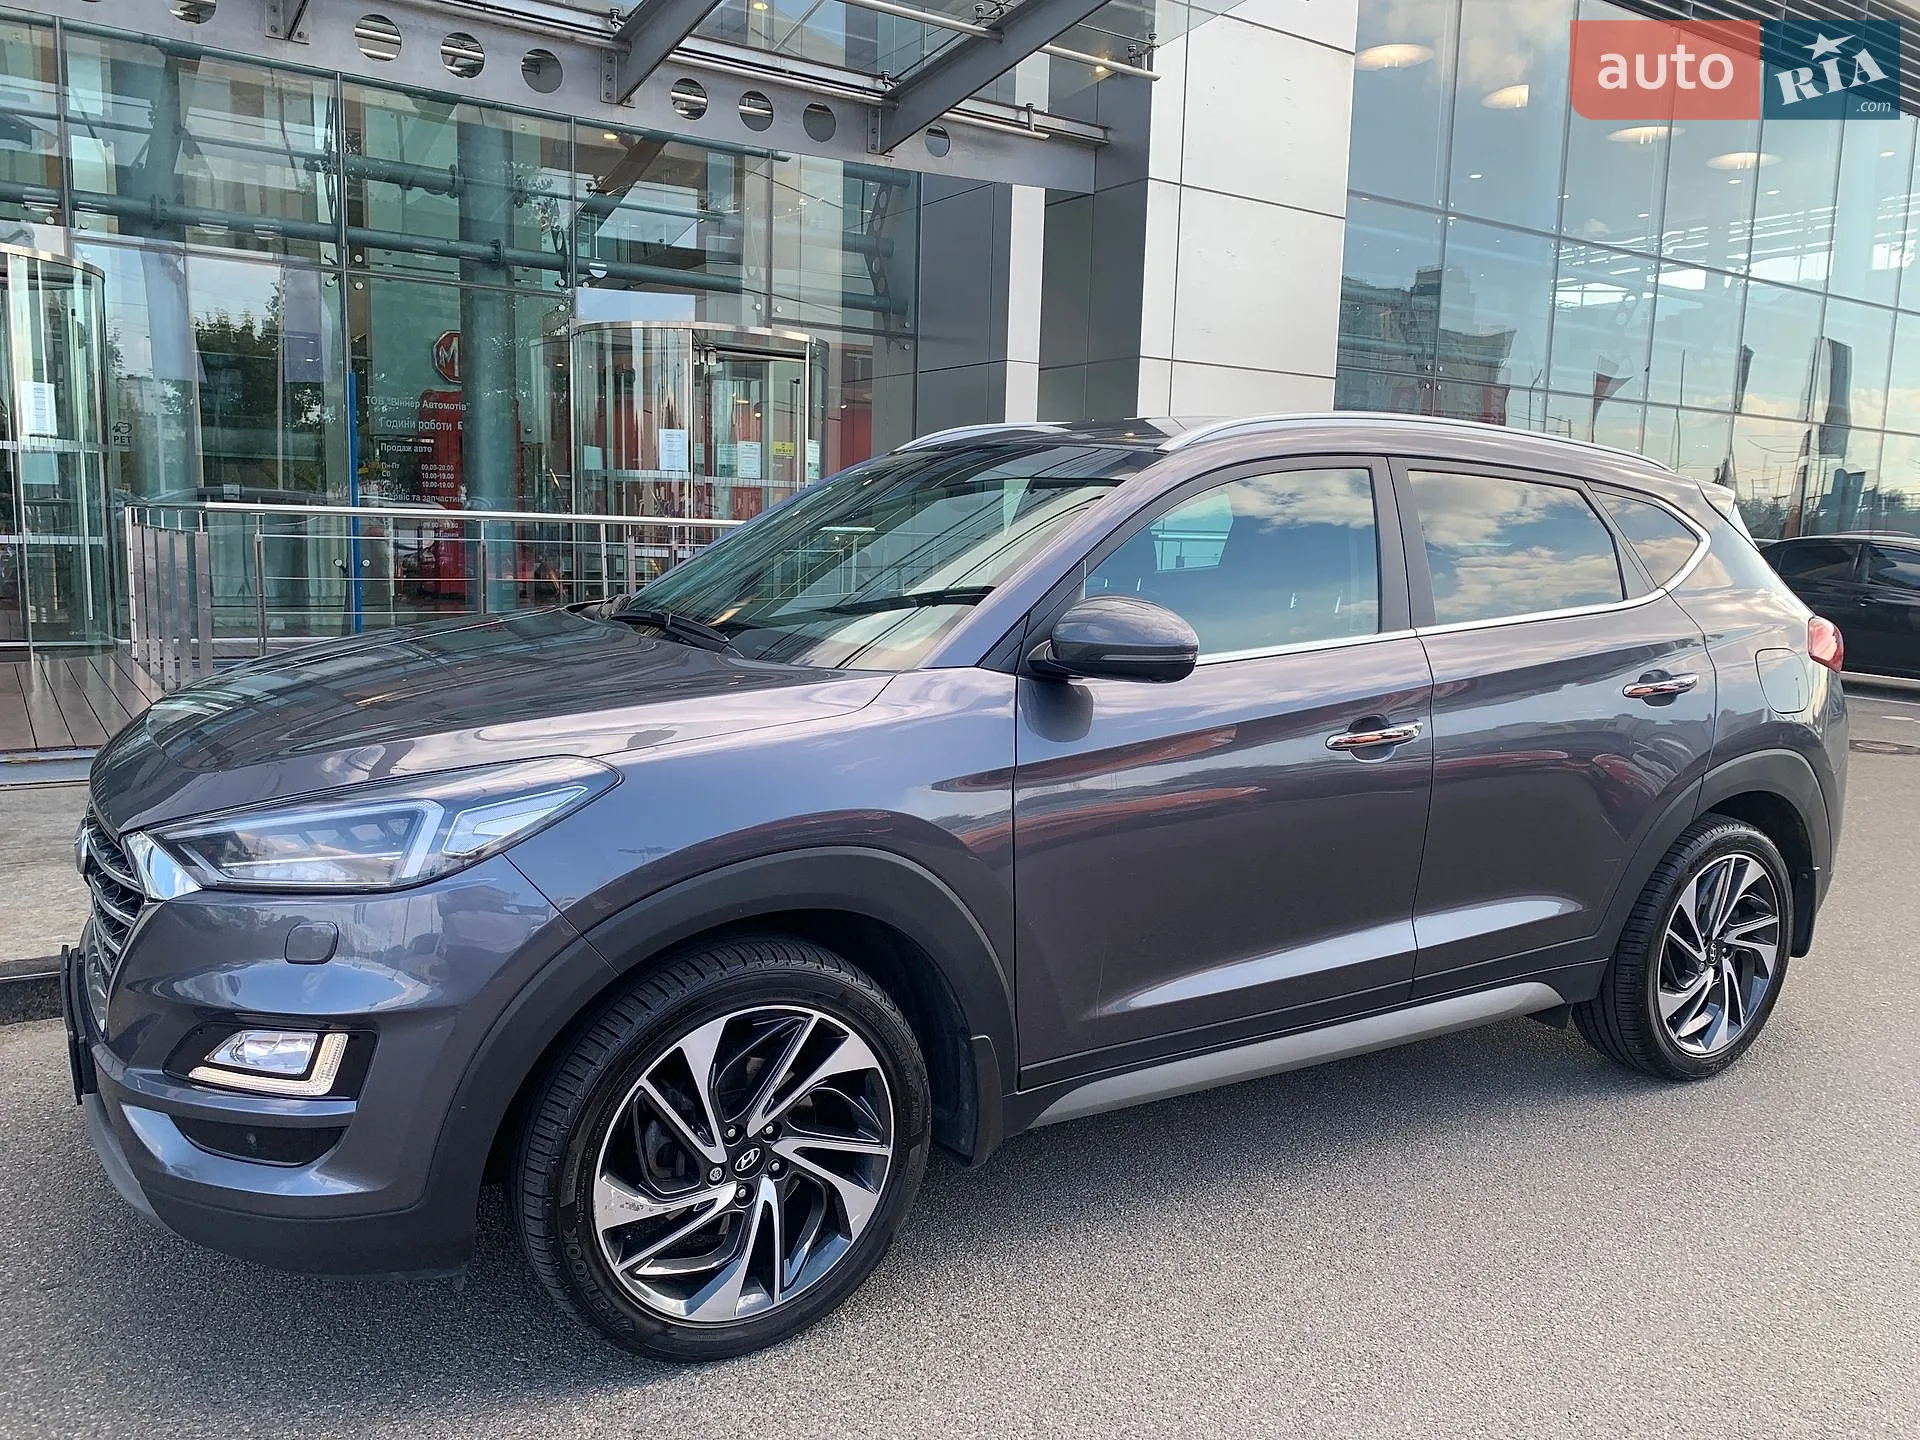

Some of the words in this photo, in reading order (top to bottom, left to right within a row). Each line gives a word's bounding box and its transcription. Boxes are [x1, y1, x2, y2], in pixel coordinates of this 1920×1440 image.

[365, 395, 385, 405] ТОВ
[380, 416, 416, 430] Години
[418, 419, 452, 431] роботи
[113, 435, 132, 443] PET
[380, 442, 412, 453] Продаж
[413, 445, 433, 453] авто
